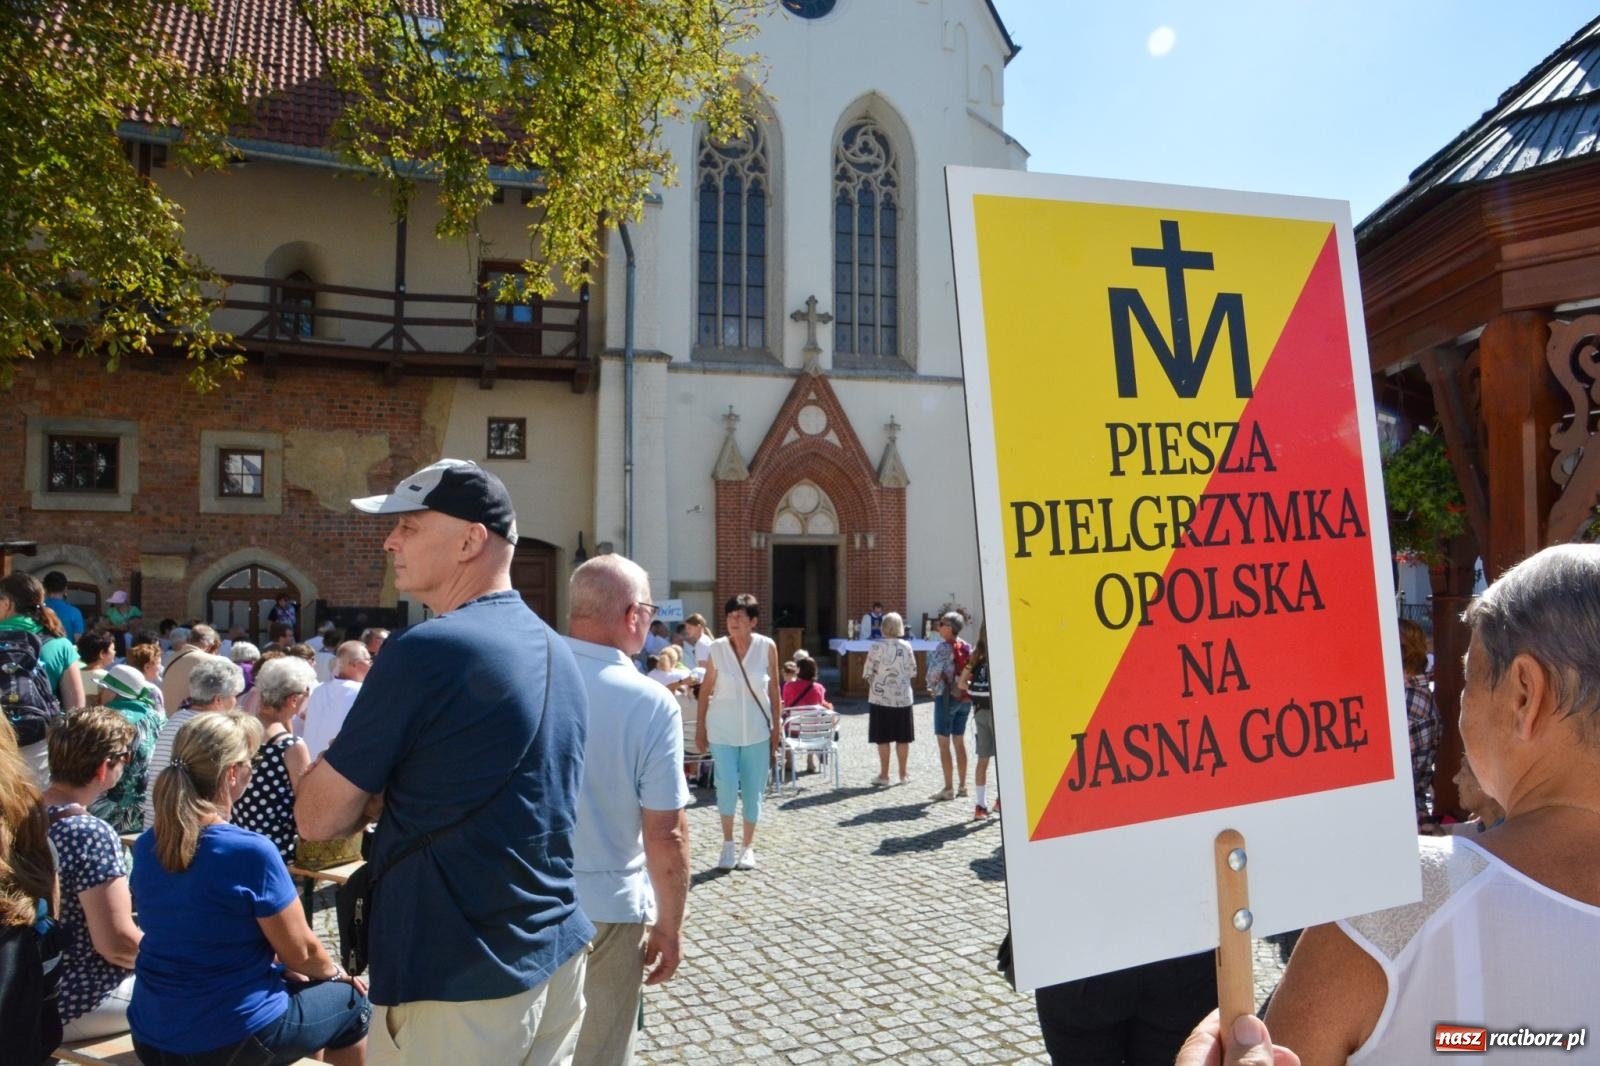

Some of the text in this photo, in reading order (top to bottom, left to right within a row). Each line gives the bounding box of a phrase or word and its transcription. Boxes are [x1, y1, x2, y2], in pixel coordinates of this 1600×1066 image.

[1105, 420, 1277, 476] PIESZA
[1010, 487, 1367, 558] PIELGRZYMKA
[1094, 559, 1325, 631] OPOLSKA
[1177, 638, 1251, 698] NA
[1068, 695, 1369, 792] JASNĄ GÓRĘ
